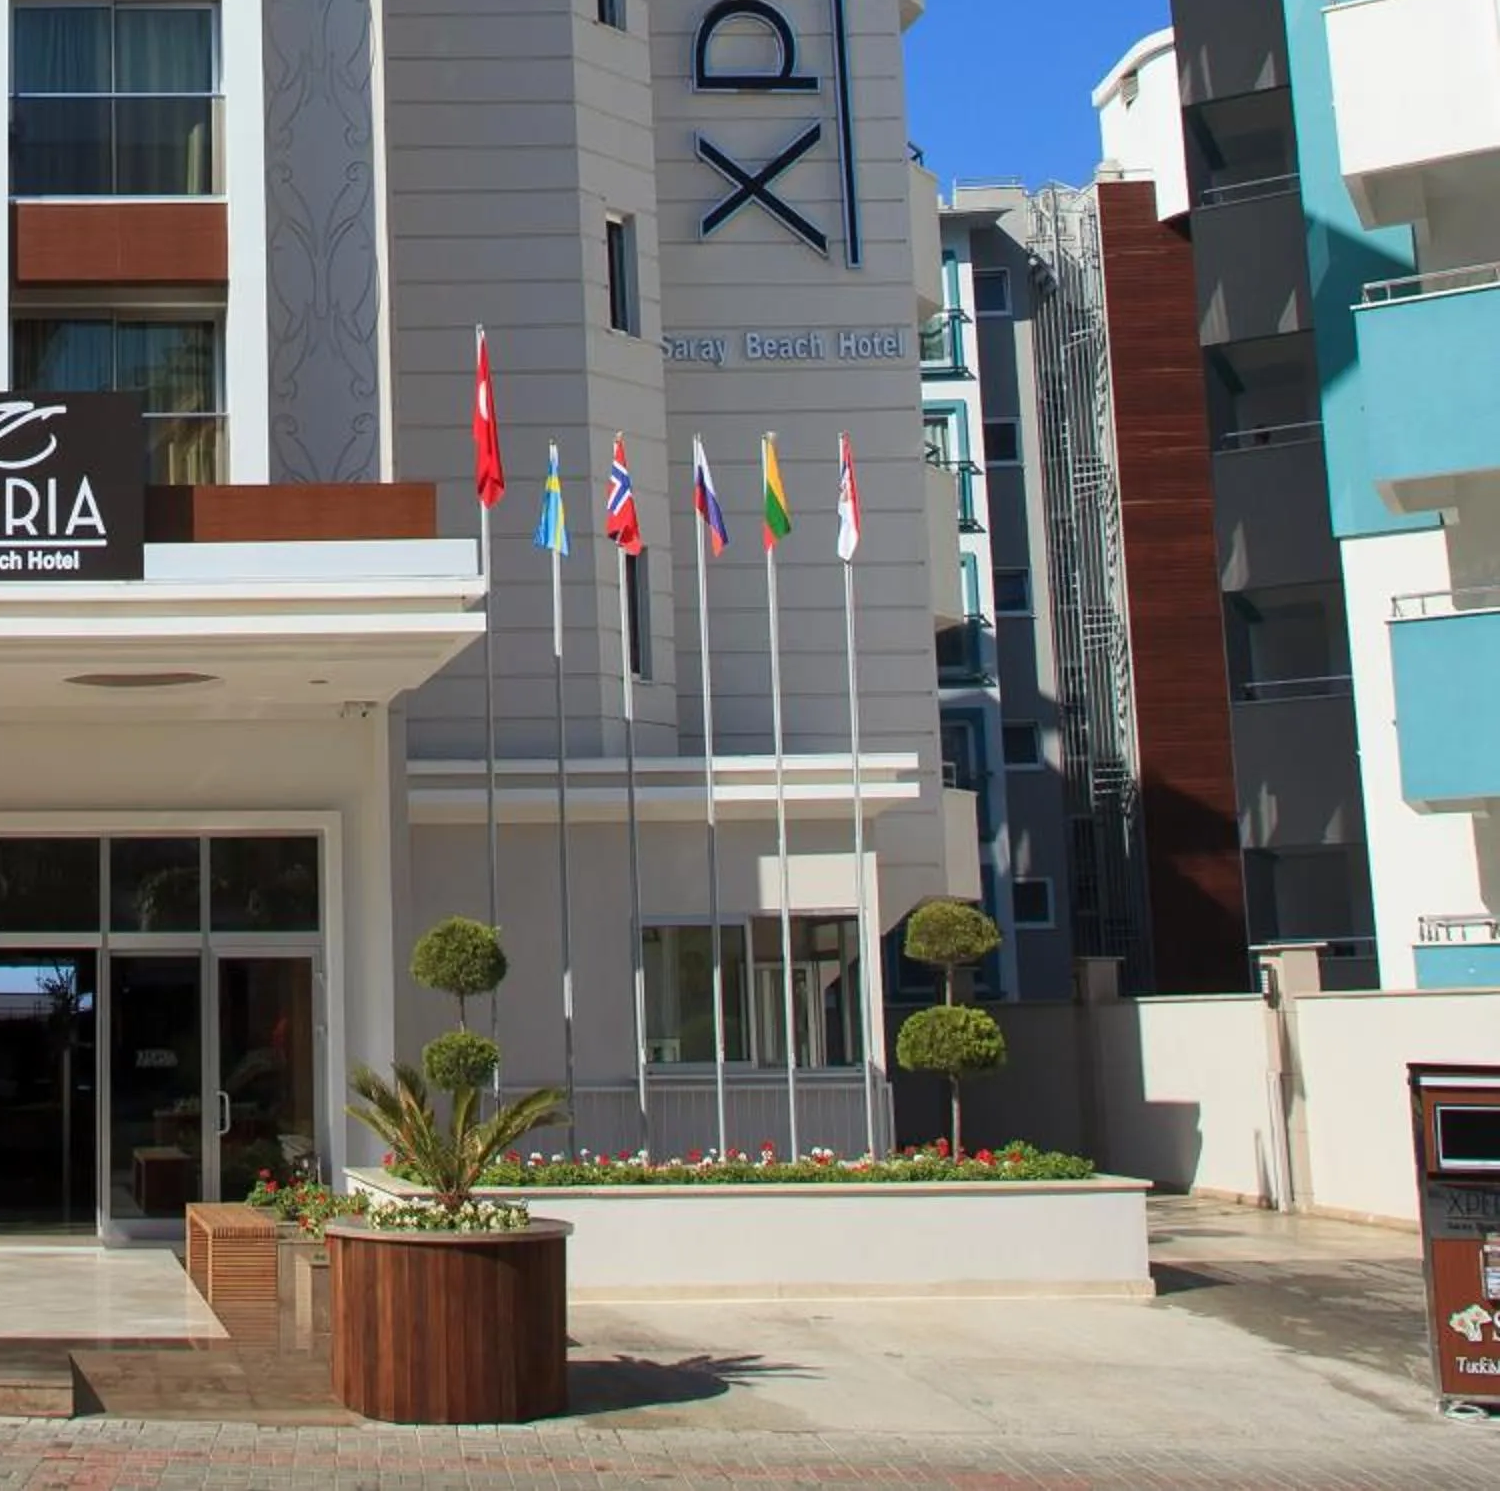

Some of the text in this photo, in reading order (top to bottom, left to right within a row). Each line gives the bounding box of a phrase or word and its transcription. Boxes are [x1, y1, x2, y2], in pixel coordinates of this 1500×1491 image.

[660, 330, 906, 366] Saray Beach Hotel
[28, 550, 80, 570] Hotel
